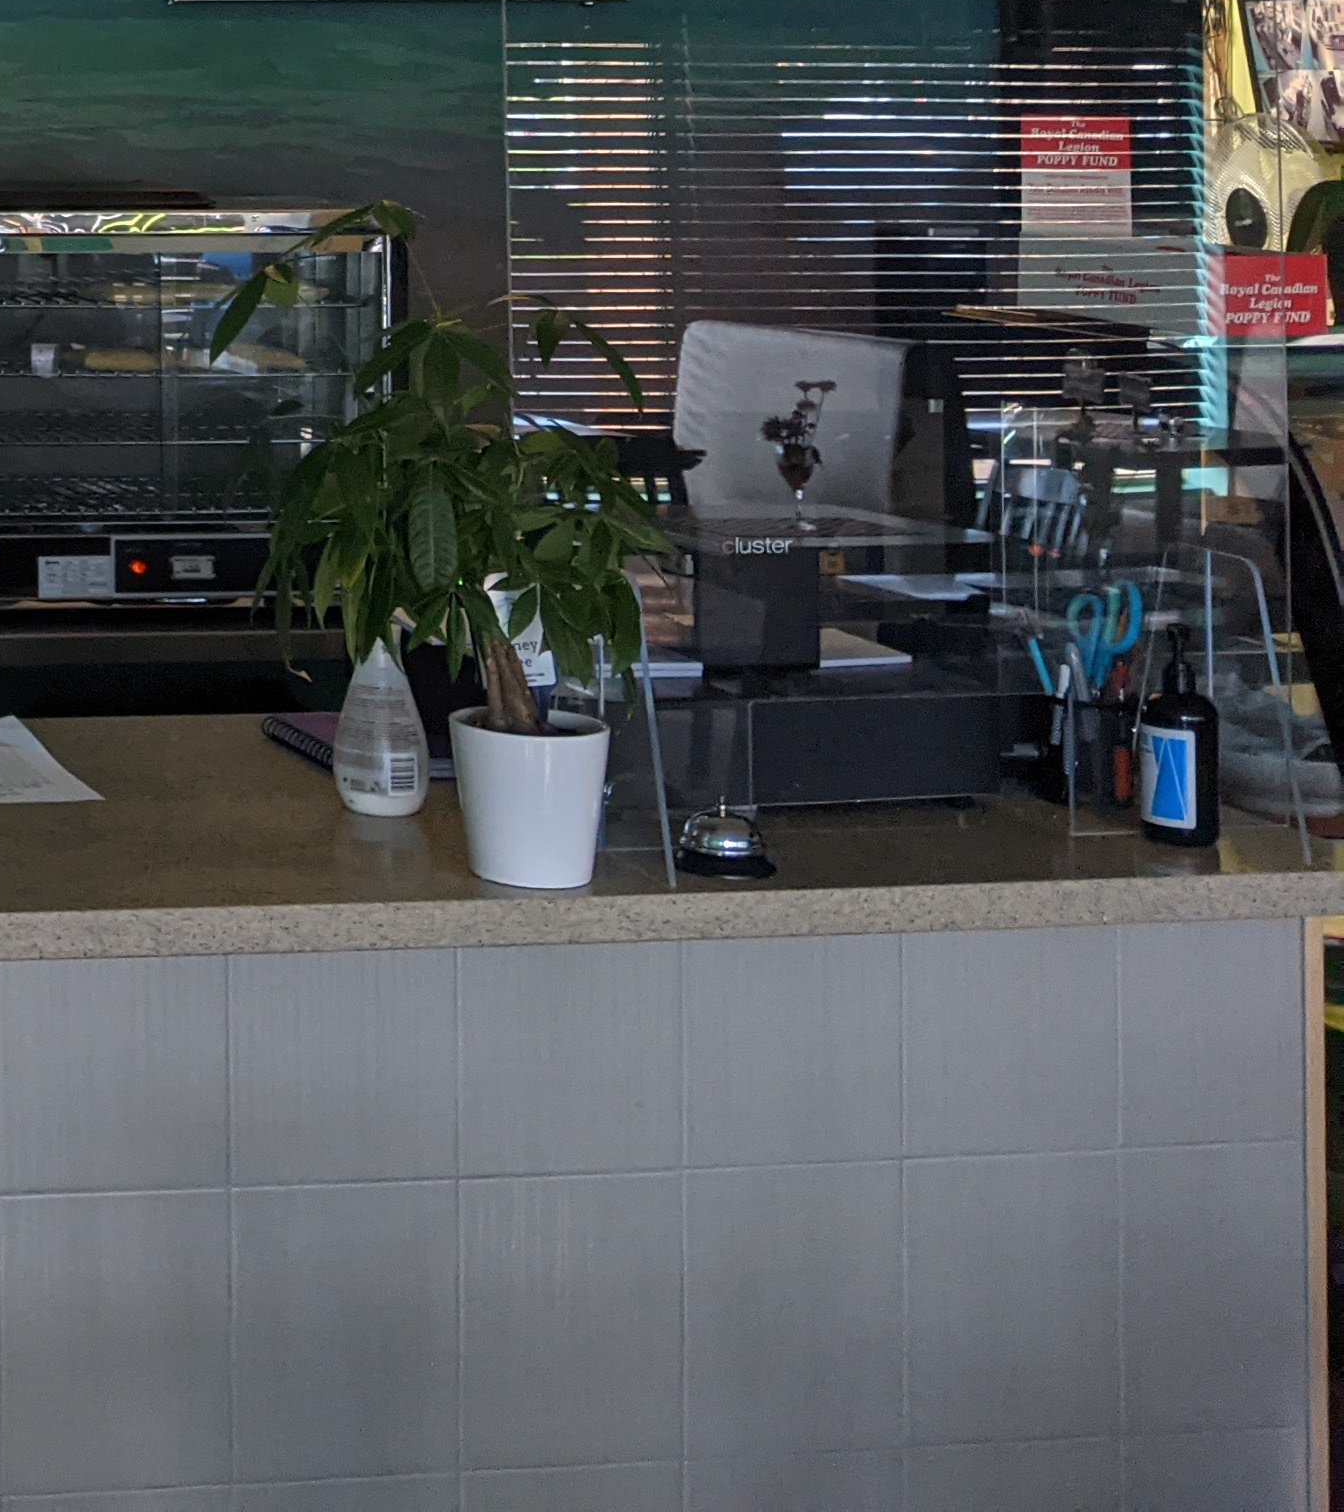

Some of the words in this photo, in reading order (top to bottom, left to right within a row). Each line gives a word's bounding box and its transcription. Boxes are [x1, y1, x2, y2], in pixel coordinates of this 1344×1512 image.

[1037, 155, 1077, 165] POPPY
[1082, 155, 1118, 167] FUND
[1225, 311, 1269, 324] POPPY
[721, 536, 793, 555] cluster
